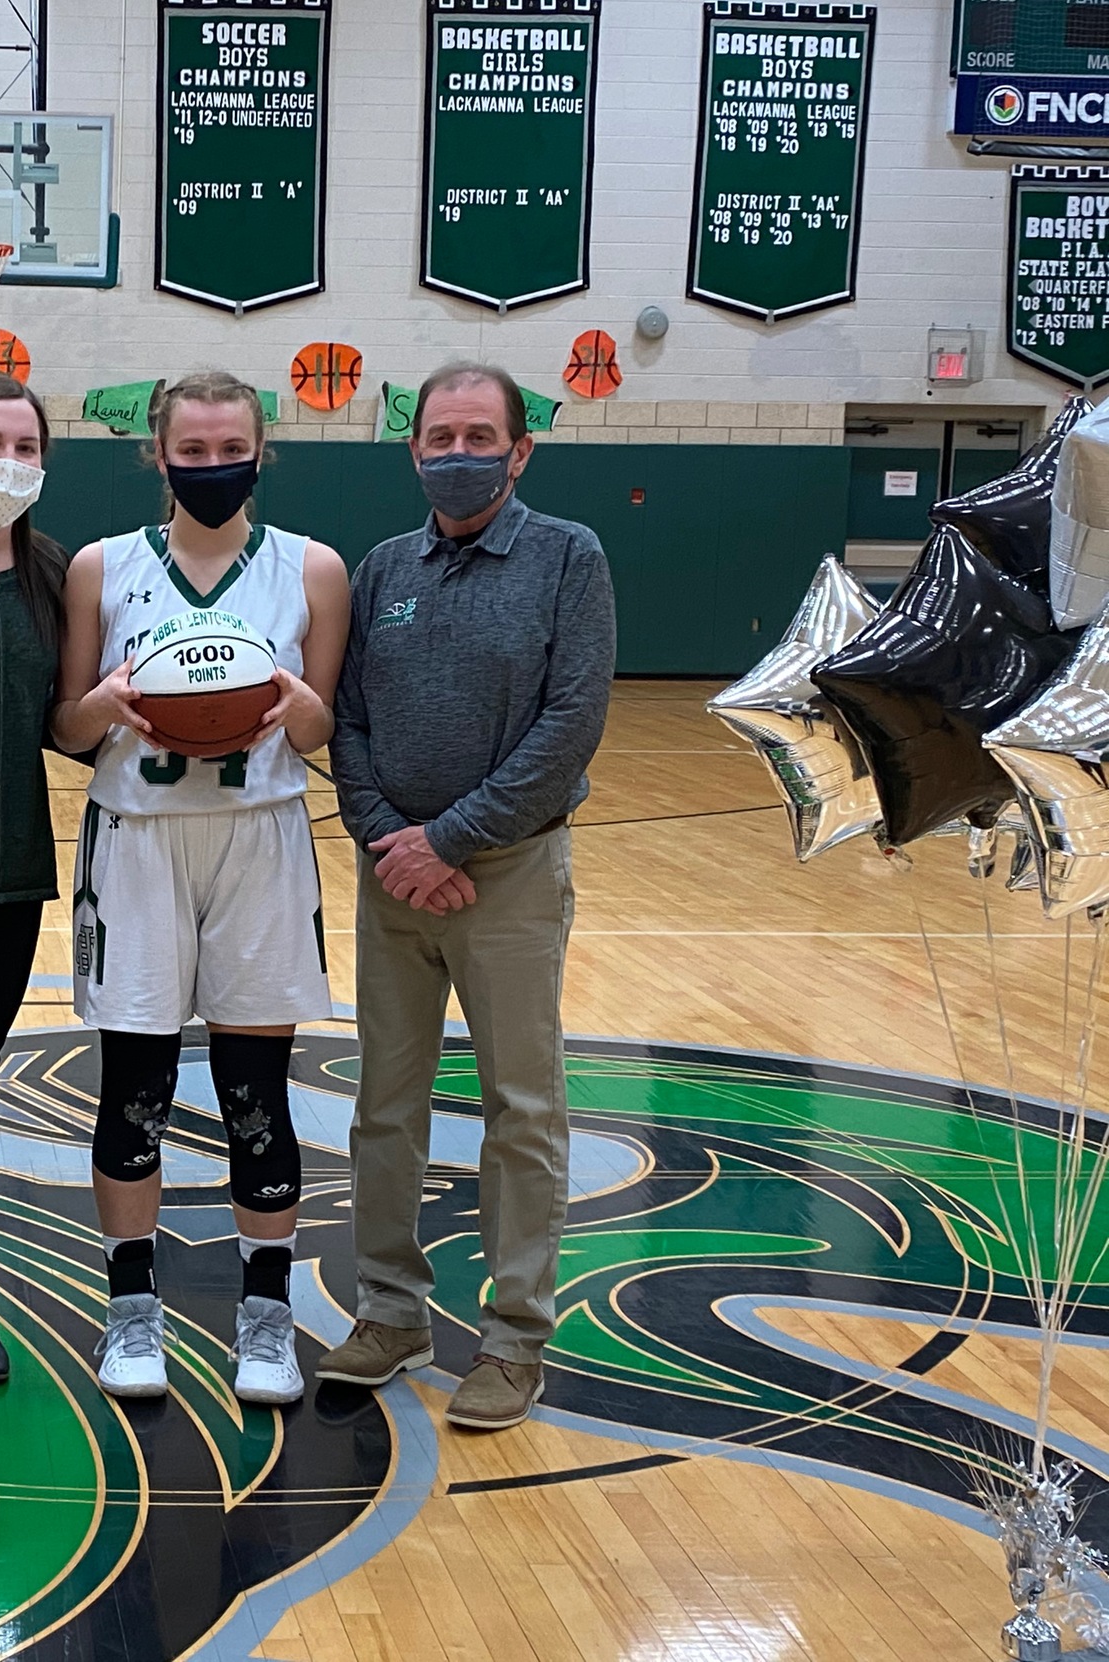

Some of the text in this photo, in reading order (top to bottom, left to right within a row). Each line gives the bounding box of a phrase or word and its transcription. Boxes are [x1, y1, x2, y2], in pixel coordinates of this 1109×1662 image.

[202, 22, 286, 46] SOCCER
[441, 27, 586, 52] BASKETBALL
[715, 32, 861, 59] BASKETBALL
[218, 46, 268, 67] BOYS
[482, 52, 544, 73] GIRLS
[966, 51, 1015, 68] SCORE
[179, 68, 306, 88] CHAMPIONS
[761, 58, 814, 79] BOYS
[448, 73, 574, 93] CHAMPIONS
[722, 79, 850, 100] CHAMPIONS
[171, 90, 315, 110] LACKAWANNA LEAGUE
[438, 95, 525, 113] LACKAWANNA
[198, 109, 228, 126] 12-0
[231, 109, 313, 128] UNDEFEATED
[712, 100, 857, 121] LACKAWANNA LEAGUE
[173, 126, 195, 145] '19
[715, 117, 856, 139] '08 '09 '12 '13 '15
[714, 133, 800, 155] '18 '19 '20
[180, 182, 242, 200] DISTRICT
[251, 182, 264, 199] II
[446, 188, 508, 205] DISTRICT
[515, 189, 529, 206] II
[172, 198, 197, 215] '09
[717, 193, 782, 211] DISTRICT
[787, 195, 802, 211] II
[1065, 195, 1109, 217] BOY
[438, 204, 461, 222] '19
[709, 208, 849, 230] '08 '09 '10 '13 '17
[708, 224, 793, 246] '18 '19 '20
[1025, 216, 1109, 240] BASKET
[1017, 259, 1070, 277] STATE
[1016, 294, 1041, 311] '08
[1046, 295, 1066, 312] '10
[1070, 295, 1091, 312] '14
[1032, 313, 1095, 329] EASTERN
[1015, 328, 1065, 346] '12 '18
[90, 390, 138, 421] Laurel
[152, 617, 184, 646] ABBEY
[173, 644, 235, 666] 1000
[188, 666, 226, 683] POINTS
